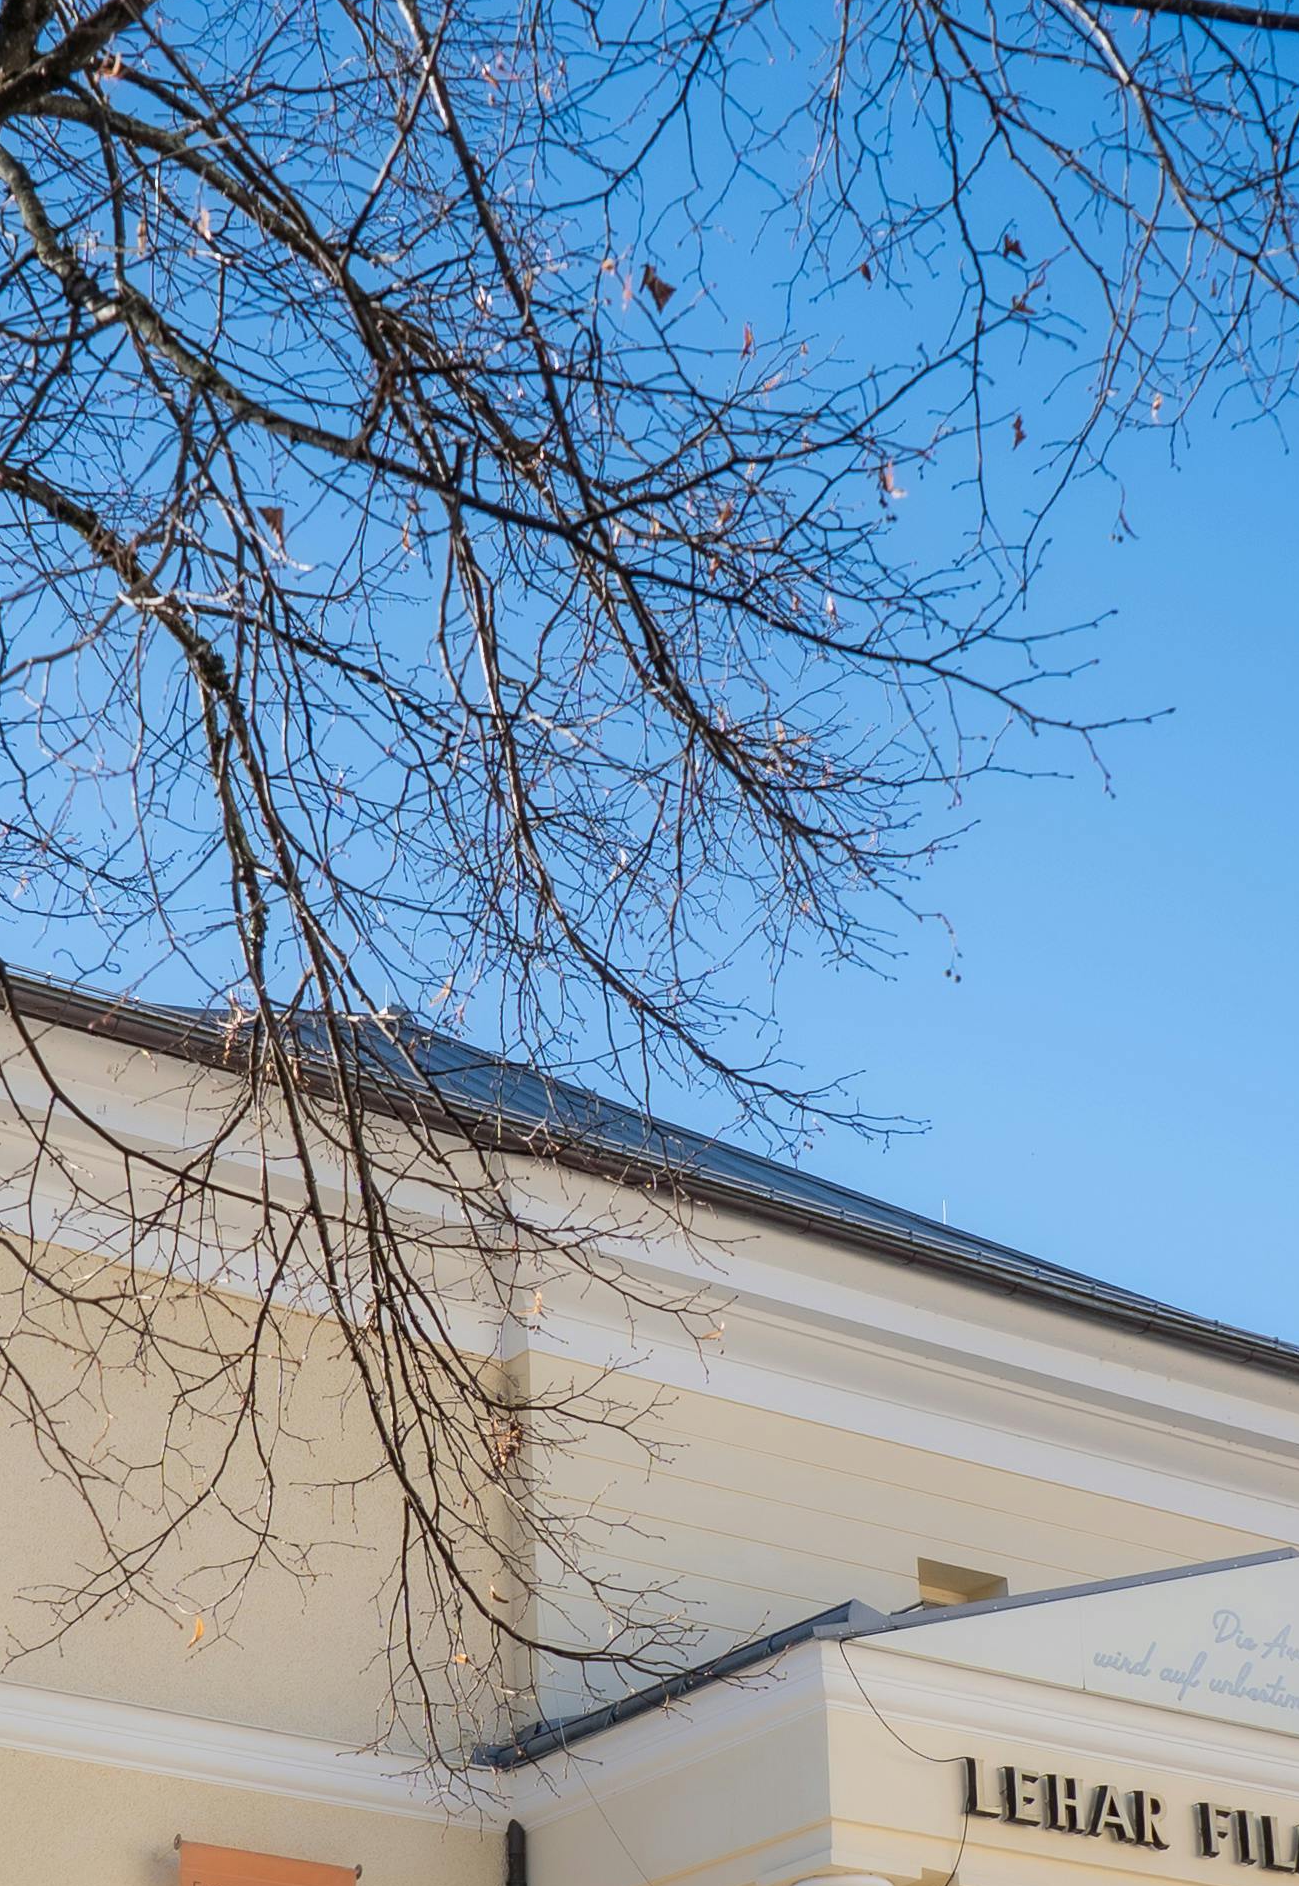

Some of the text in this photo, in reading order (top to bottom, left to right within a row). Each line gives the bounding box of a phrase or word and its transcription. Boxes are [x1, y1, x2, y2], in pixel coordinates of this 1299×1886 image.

[1213, 1609, 1257, 1651] Die
[1094, 1641, 1151, 1679] wird
[1159, 1650, 1208, 1701] auf
[965, 1757, 1170, 1850] LEHAR
